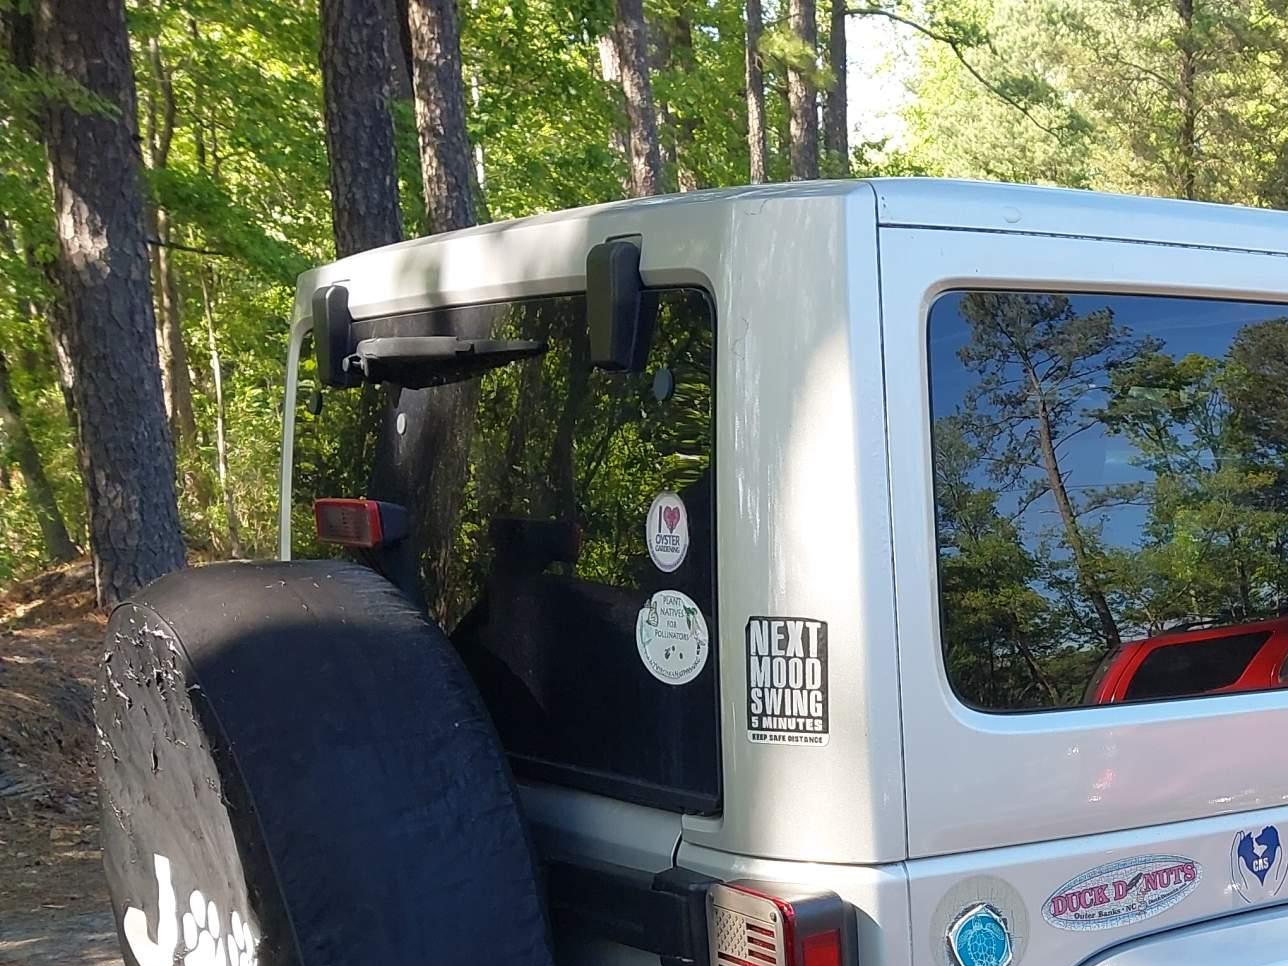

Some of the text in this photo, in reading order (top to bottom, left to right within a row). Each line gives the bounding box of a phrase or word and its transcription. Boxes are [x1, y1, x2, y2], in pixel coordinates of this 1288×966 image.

[655, 534, 681, 546] OYSTER
[654, 544, 681, 554] GARDENING
[663, 596, 682, 606] PLANT
[660, 607, 685, 618] NATIVES
[667, 620, 677, 629] FOR
[654, 628, 690, 641] POLLINATORS
[750, 620, 822, 658] NEXT
[750, 655, 822, 690] MOOD
[750, 687, 823, 717] SWING
[751, 716, 823, 731] 5 MINUTES
[752, 733, 823, 743] KEEP SAFE DISTANCE
[1252, 856, 1269, 873] CAS
[1051, 883, 1111, 917] DUCK
[1074, 903, 1137, 920] Outer Banks NC
